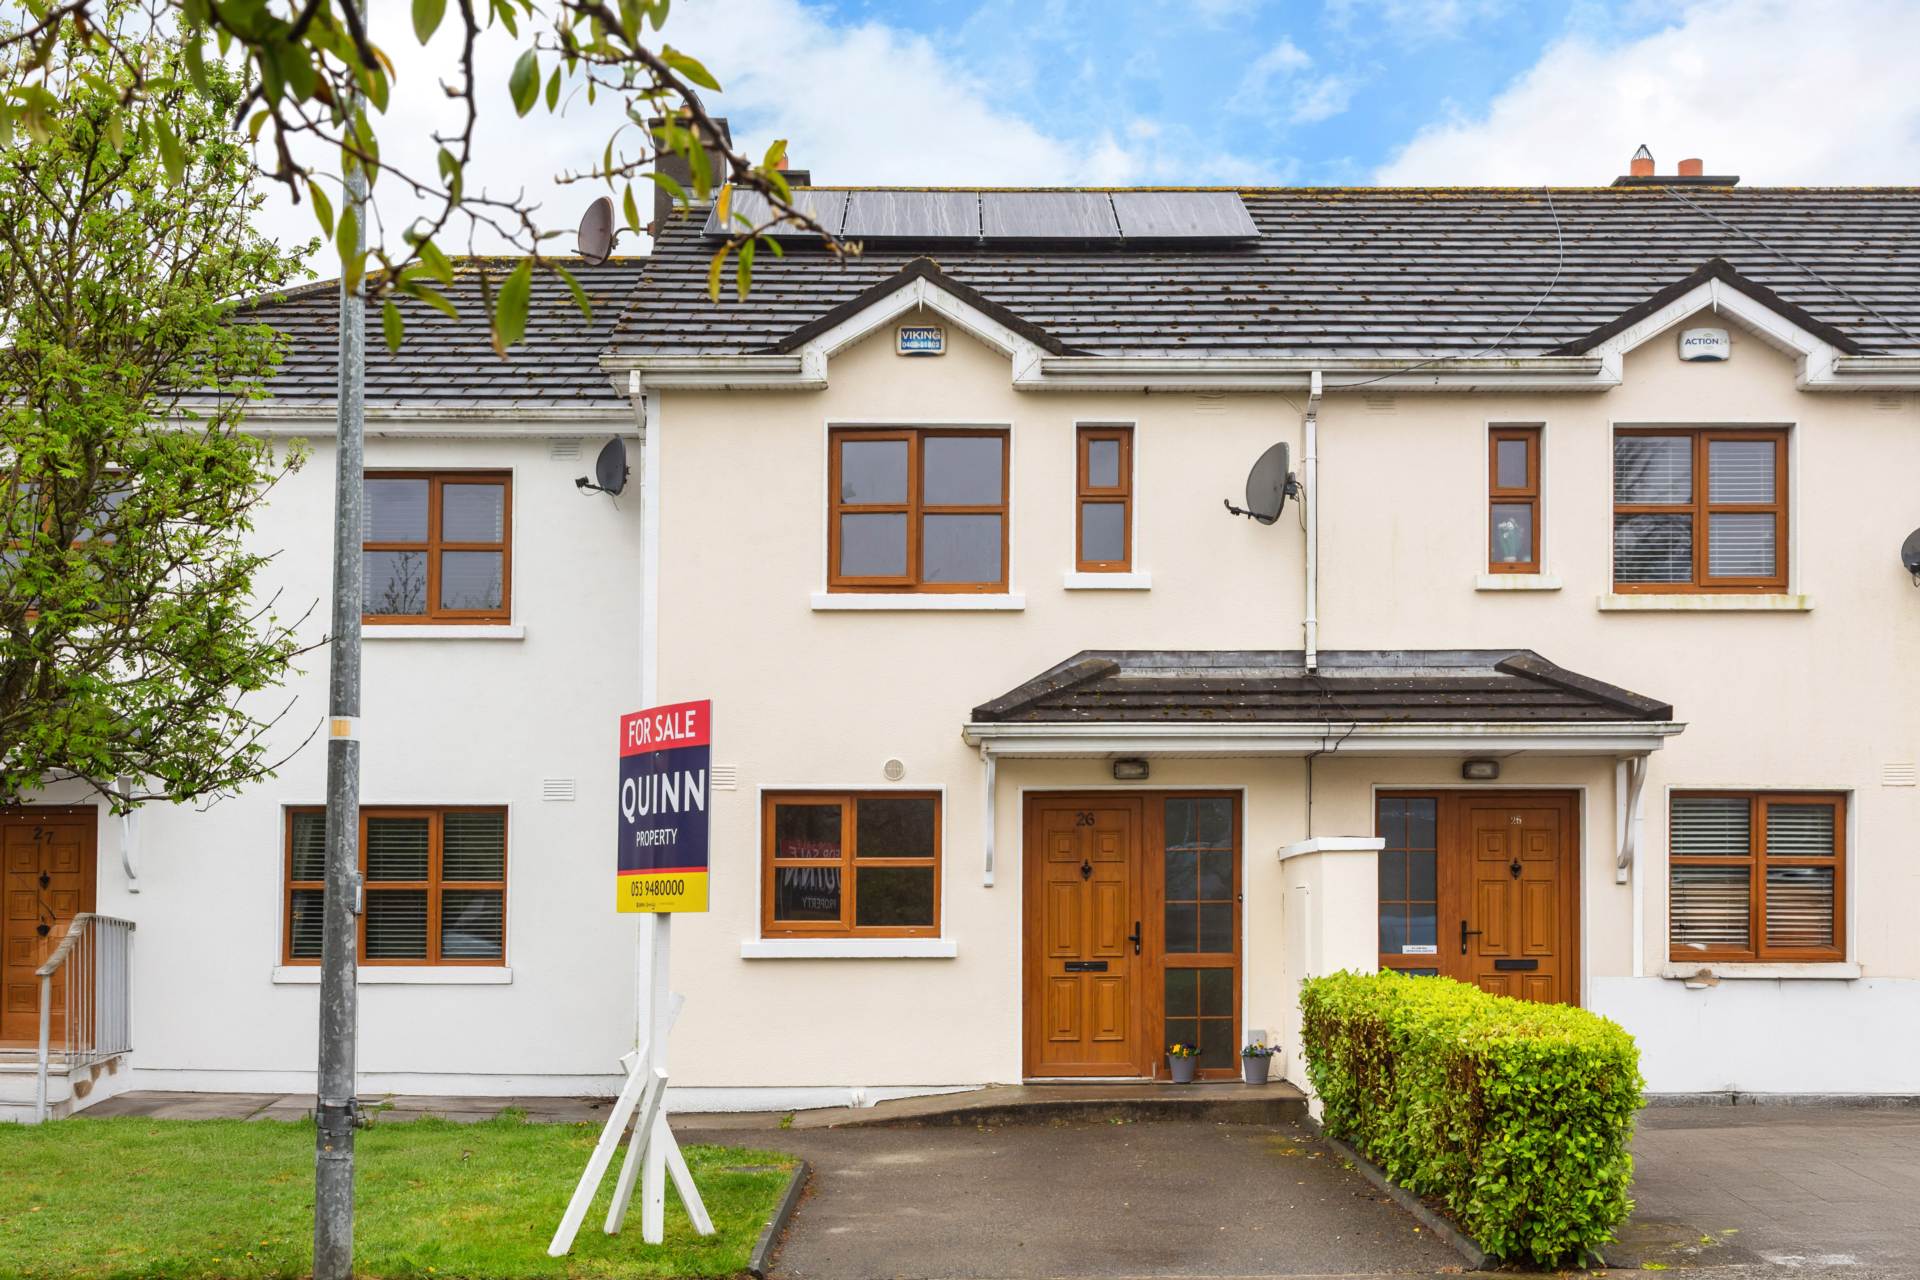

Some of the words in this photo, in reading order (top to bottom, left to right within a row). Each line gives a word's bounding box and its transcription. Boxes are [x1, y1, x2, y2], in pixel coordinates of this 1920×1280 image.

[902, 331, 940, 340] VIKING
[628, 717, 651, 747] FOR
[655, 709, 696, 742] SALE
[621, 769, 705, 824] QUINN
[1075, 811, 1096, 826] 26
[33, 825, 54, 845] 27
[636, 828, 678, 848] PROPERTY
[631, 881, 643, 897] 053
[644, 879, 685, 896] 9480000
